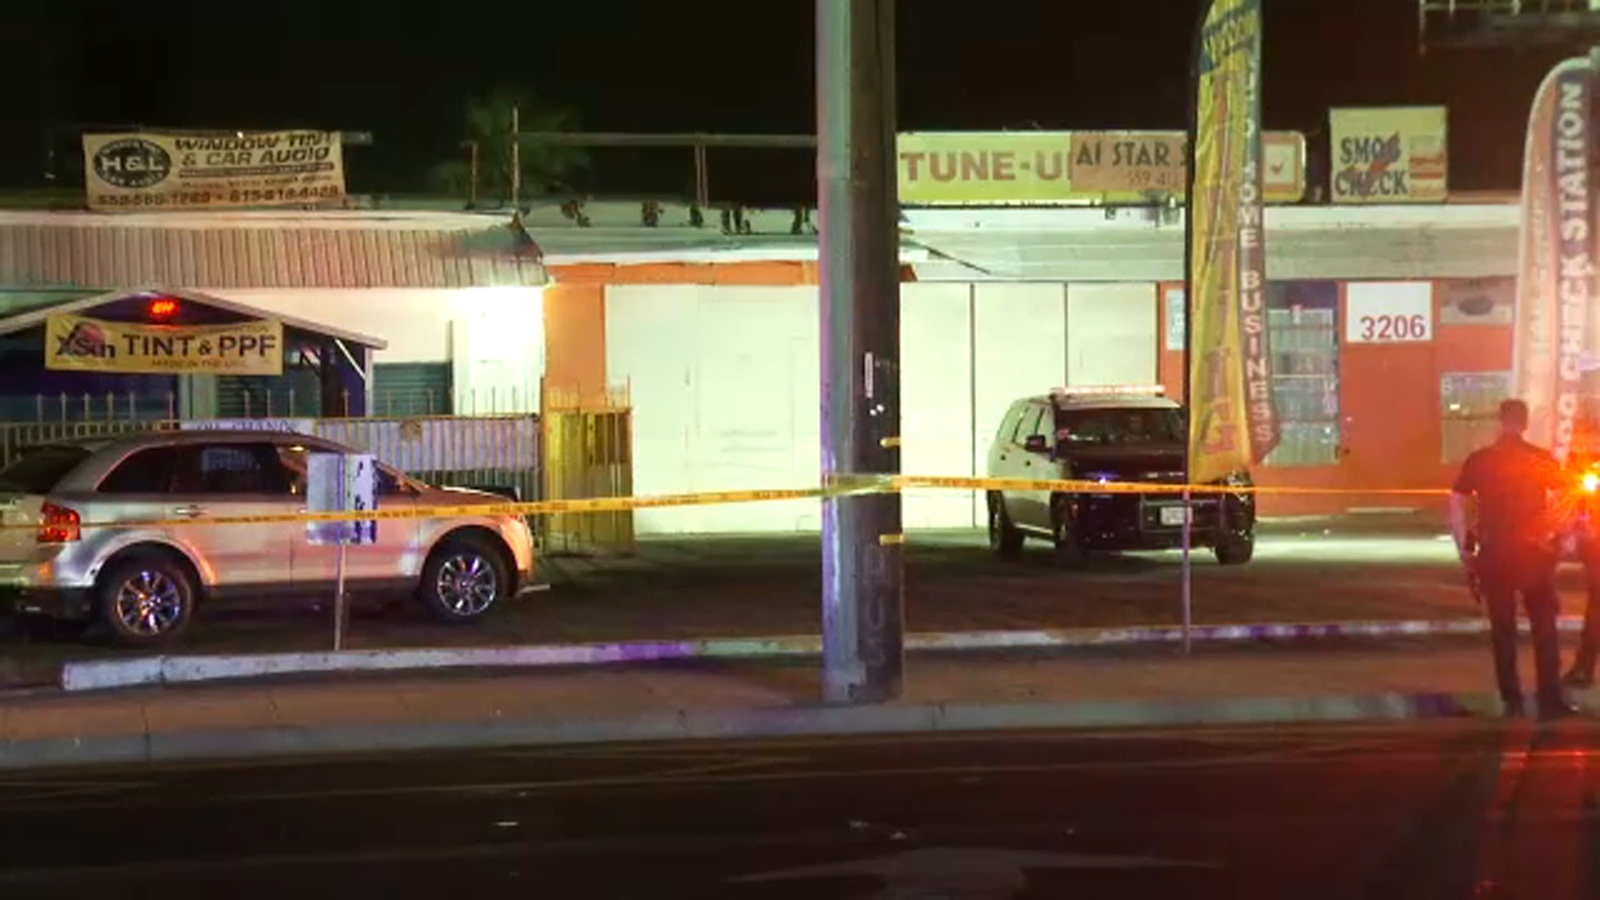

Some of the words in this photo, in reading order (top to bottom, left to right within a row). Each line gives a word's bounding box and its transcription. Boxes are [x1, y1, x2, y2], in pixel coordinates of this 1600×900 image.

[174, 135, 281, 151] WINDOW
[1112, 141, 1170, 167] STAR
[101, 156, 164, 171] H&L
[206, 151, 253, 167] CAR
[259, 147, 330, 165] AUDIO
[899, 150, 1071, 183] TUNE-U
[1557, 82, 1589, 241] STATION
[1359, 314, 1426, 341] 3206
[1559, 253, 1592, 382] CHECK
[122, 333, 196, 357] TINT
[197, 340, 213, 357] &
[218, 334, 276, 358] PPF
[1240, 269, 1274, 443] BUSINESS
